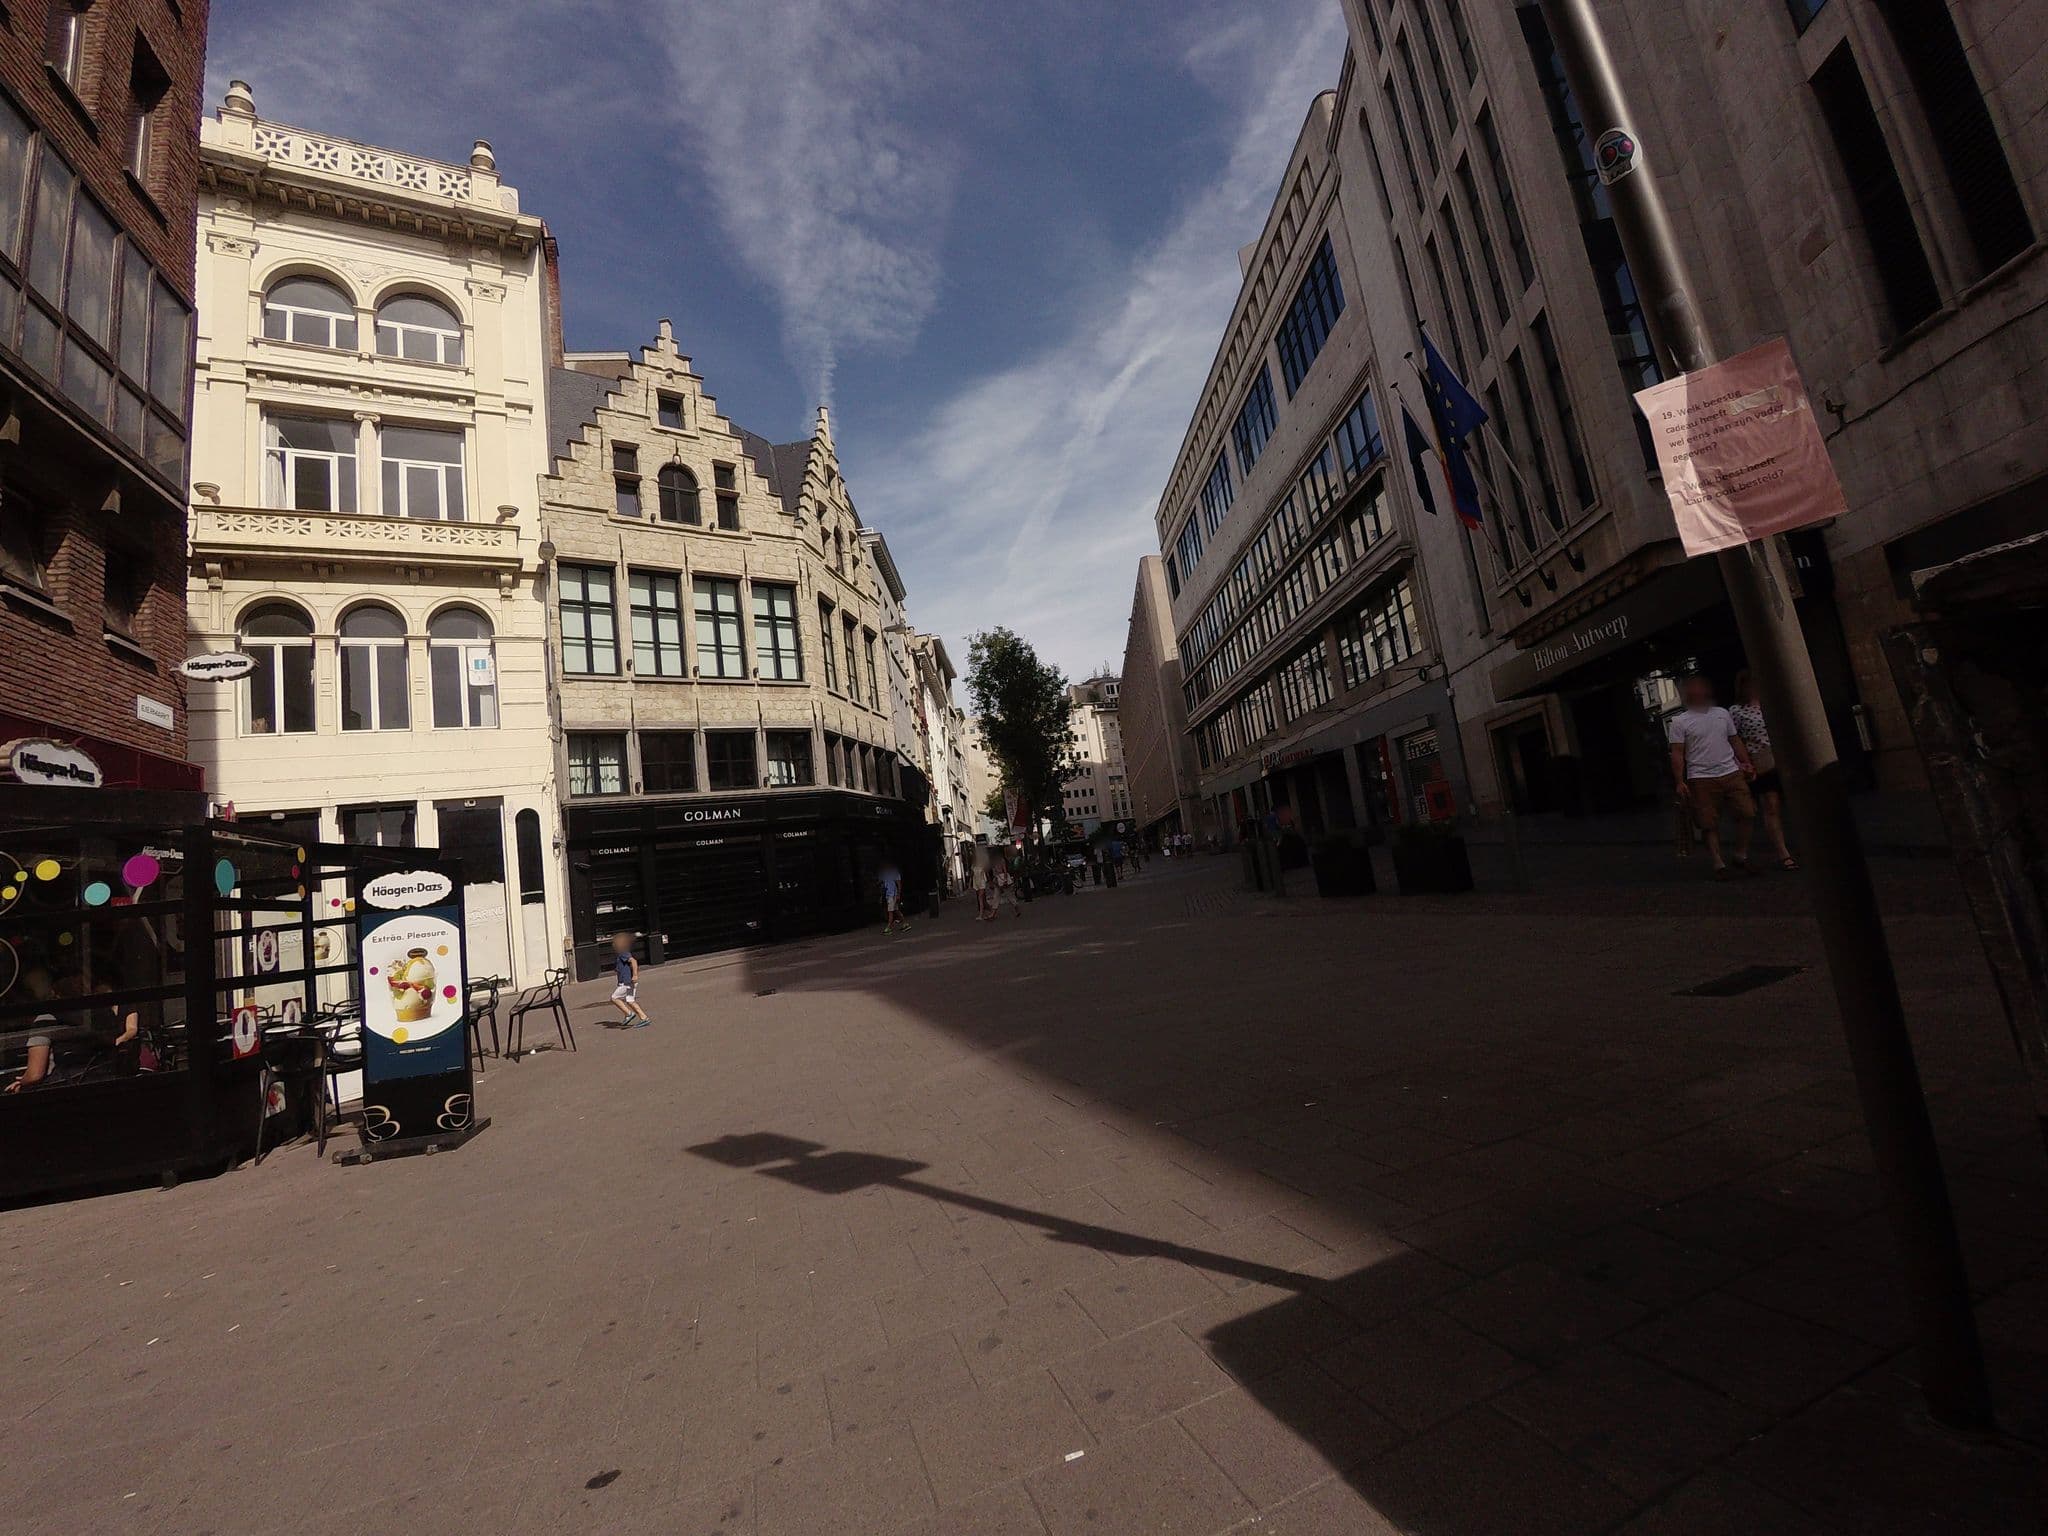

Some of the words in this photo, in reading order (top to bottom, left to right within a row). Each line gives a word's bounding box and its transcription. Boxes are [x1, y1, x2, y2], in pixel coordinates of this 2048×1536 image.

[1678, 405, 1701, 417] Welk
[1665, 420, 1698, 434] cadeau
[1700, 409, 1727, 424] heeft
[1669, 438, 1685, 448] wel
[1713, 423, 1732, 435] aan
[1754, 404, 1783, 420] vader
[1672, 442, 1717, 463] gegeven?
[1747, 457, 1776, 472] heeft
[1533, 645, 1569, 671] Hilton
[1571, 616, 1628, 655] Antwerp
[187, 660, 248, 672] Häagen-Dazs
[20, 752, 95, 782] Häagen-Dazs
[684, 808, 742, 822] COLMAN
[783, 830, 808, 839] COLMAN
[696, 838, 724, 847] COLMAN
[598, 846, 631, 857] COLMAN
[372, 883, 443, 897] Häagen-Dazs
[407, 930, 449, 940] Pleasure.
